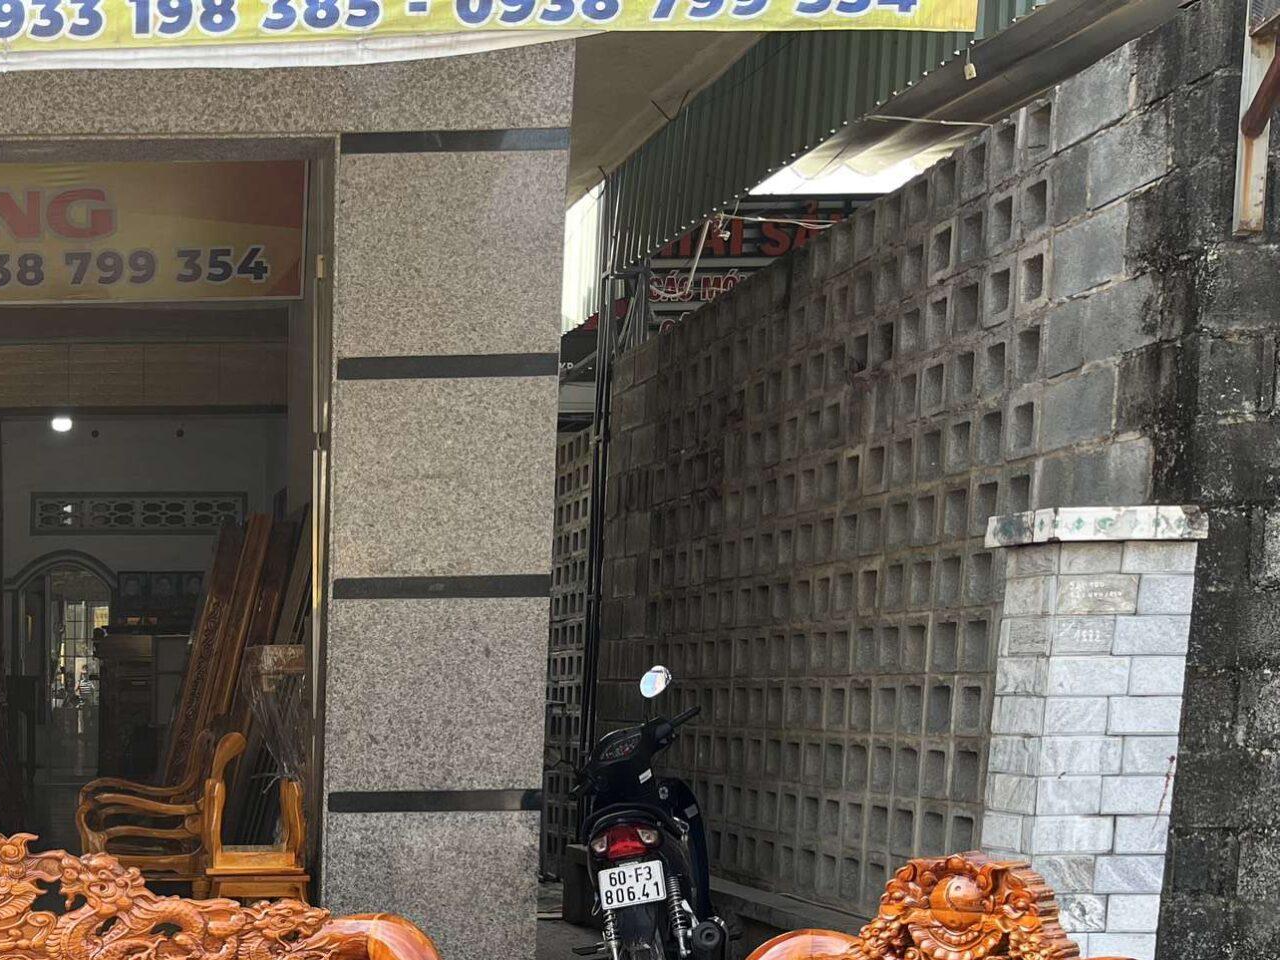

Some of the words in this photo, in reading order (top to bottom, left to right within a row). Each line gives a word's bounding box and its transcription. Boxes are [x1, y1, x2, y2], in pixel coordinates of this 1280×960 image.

[132, 0, 235, 34] 198
[64, 251, 156, 285] 799
[176, 247, 267, 283] 354
[609, 866, 652, 886] 60-F3
[605, 881, 660, 905] 806.41
